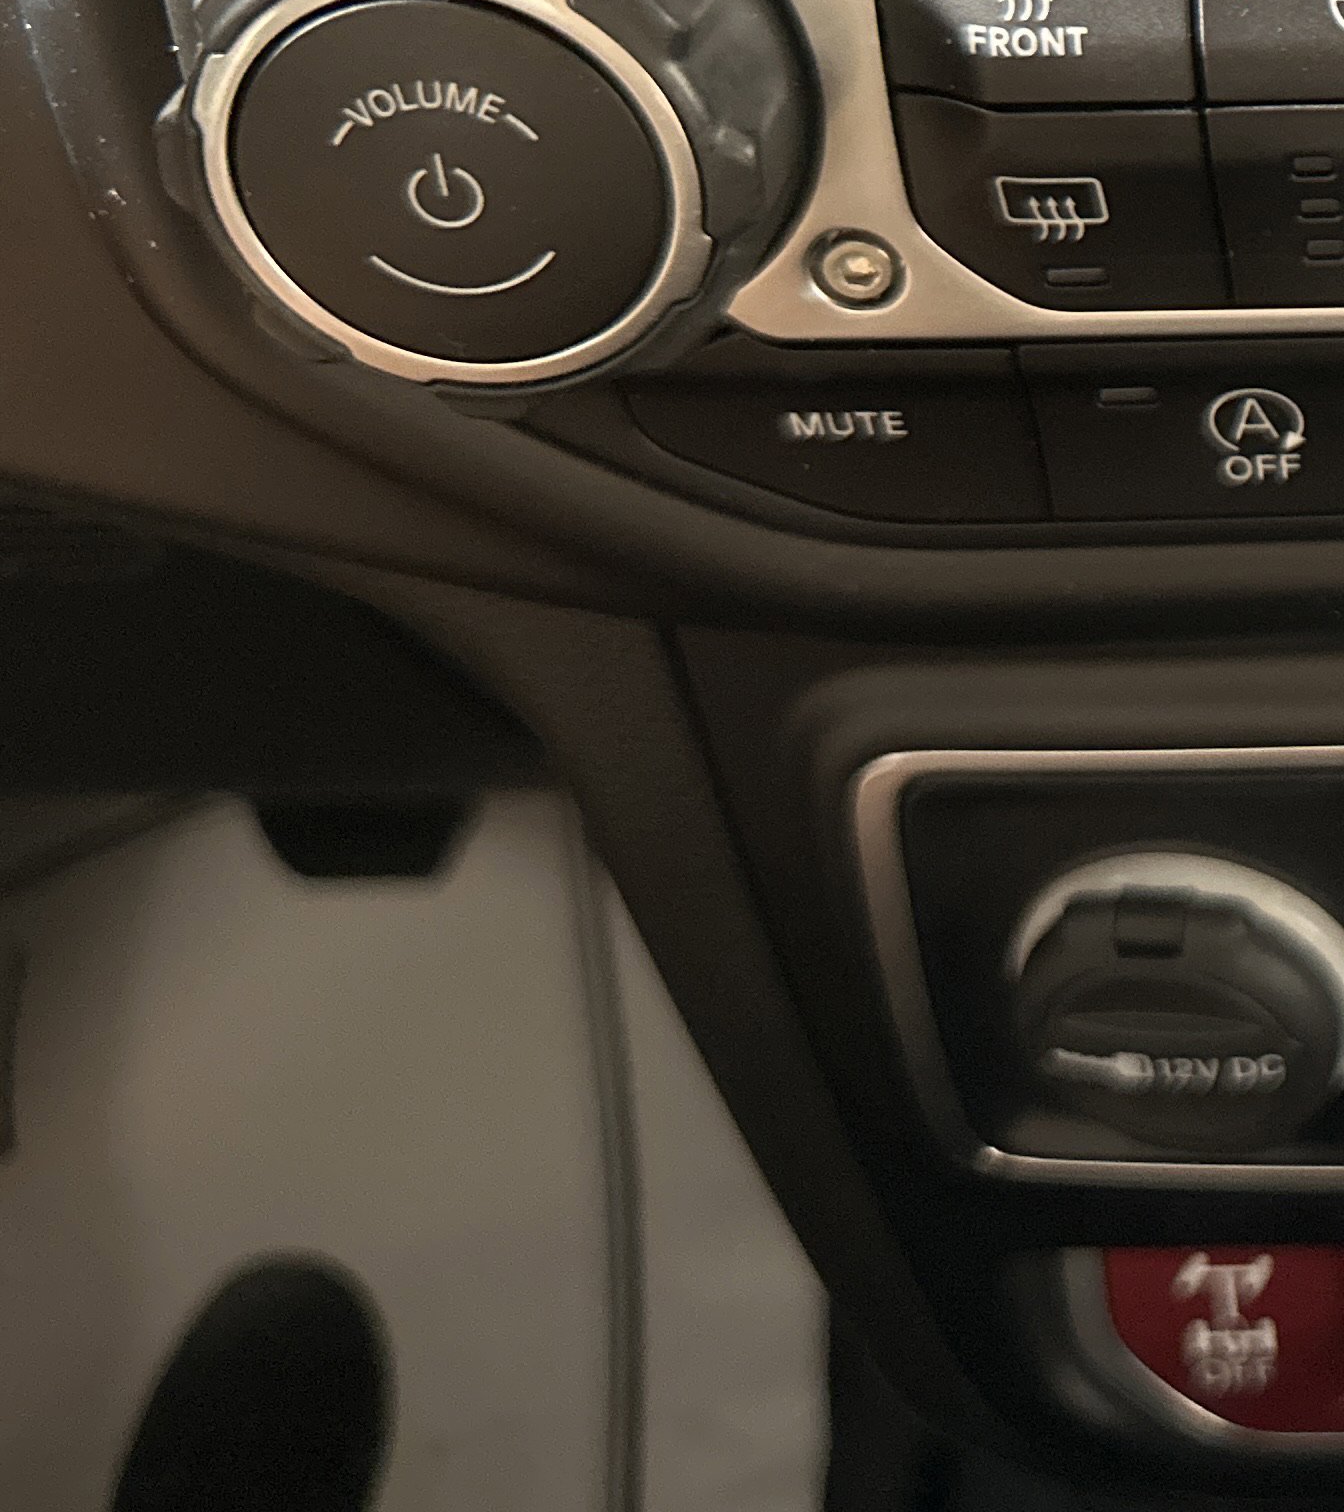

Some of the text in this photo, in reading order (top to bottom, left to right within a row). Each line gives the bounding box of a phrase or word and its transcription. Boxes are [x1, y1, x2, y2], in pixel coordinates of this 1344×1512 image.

[966, 23, 1089, 58] FRONT
[346, 81, 506, 129] VOLUME
[785, 410, 909, 441] MUTE
[1221, 453, 1302, 485] OFF
[1153, 1053, 1288, 1091] 12V DC
